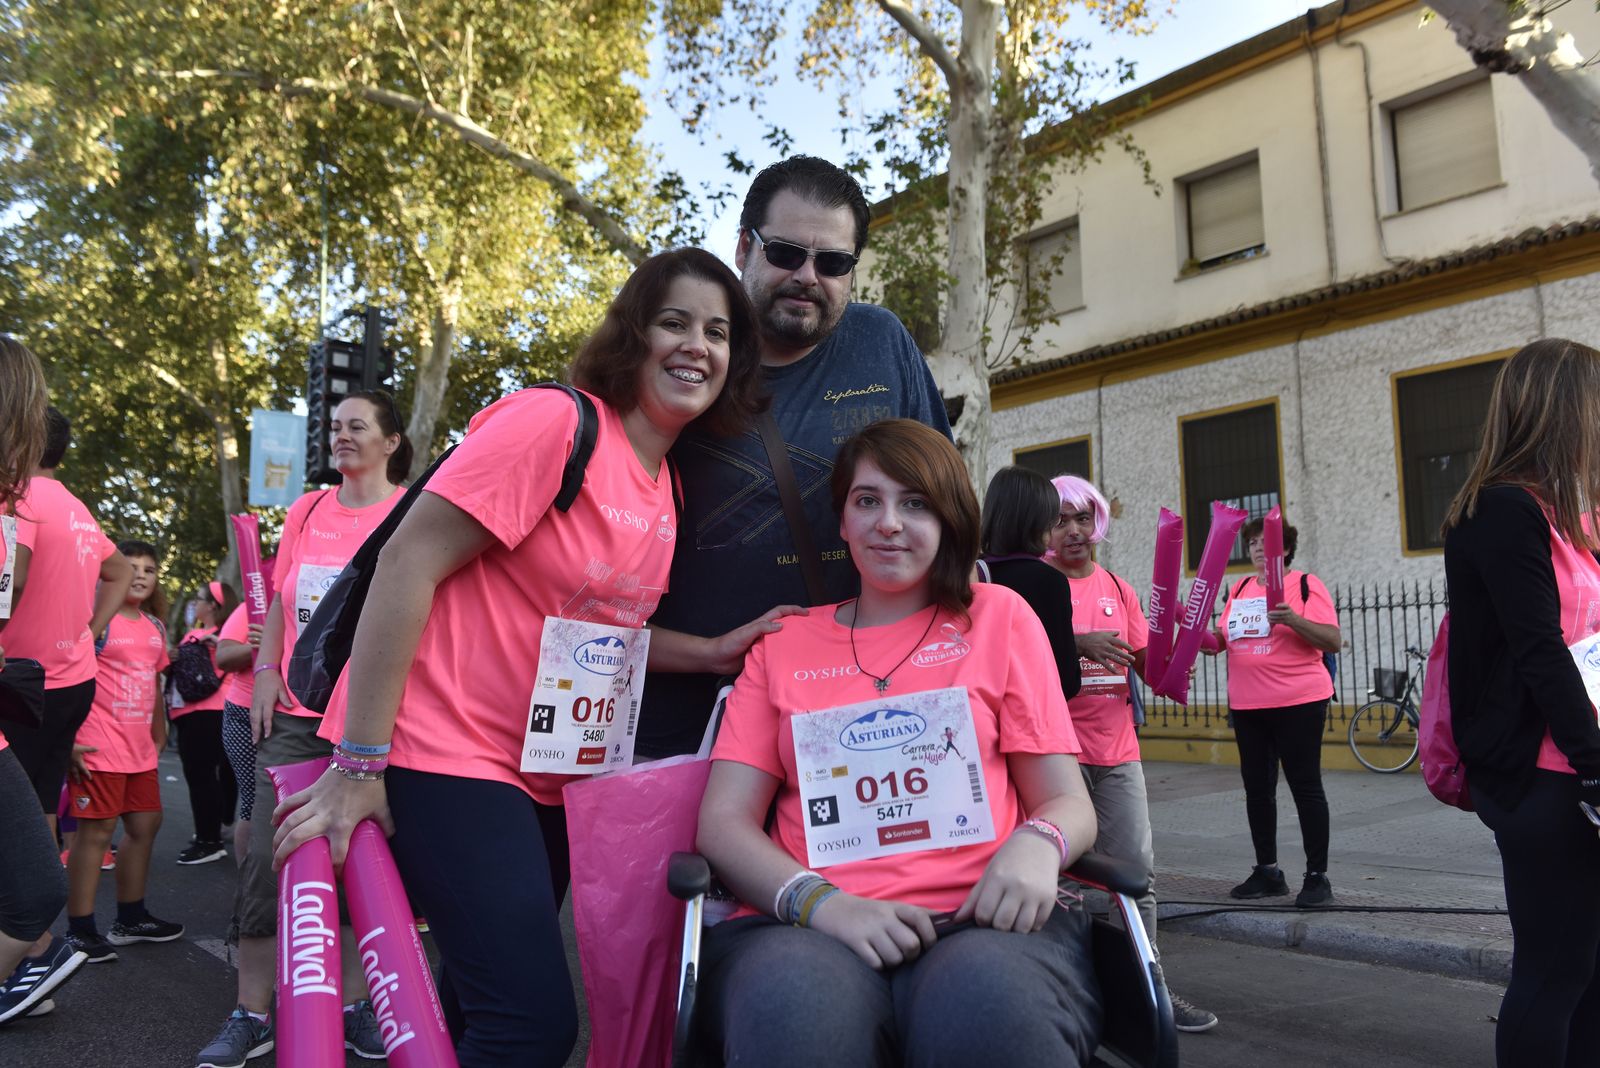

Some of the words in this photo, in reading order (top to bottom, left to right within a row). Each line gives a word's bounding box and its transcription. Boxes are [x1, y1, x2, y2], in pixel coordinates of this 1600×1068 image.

[823, 383, 890, 404] Exploration
[821, 550, 848, 561] DESER
[246, 572, 267, 615] Ladival
[1149, 583, 1168, 634] Ladival
[1181, 577, 1208, 630] Ladival
[1241, 615, 1261, 625] 016
[916, 647, 968, 664] ASTURIANA
[1252, 645, 1272, 655] 2019
[794, 664, 861, 682] OYSHO
[572, 696, 615, 723] 016
[582, 729, 605, 742] 5480
[847, 722, 921, 746] ASTURIANA
[529, 748, 565, 760] OYSHO
[901, 743, 935, 755] Carrera
[924, 752, 948, 766] Mujer
[855, 767, 929, 804] 016
[877, 803, 913, 821] 5477
[891, 830, 924, 839] Santander
[949, 828, 980, 838] ZURICH
[817, 836, 862, 853] OYSHO
[292, 881, 337, 997] Ladival
[358, 926, 415, 1057] Ladival
